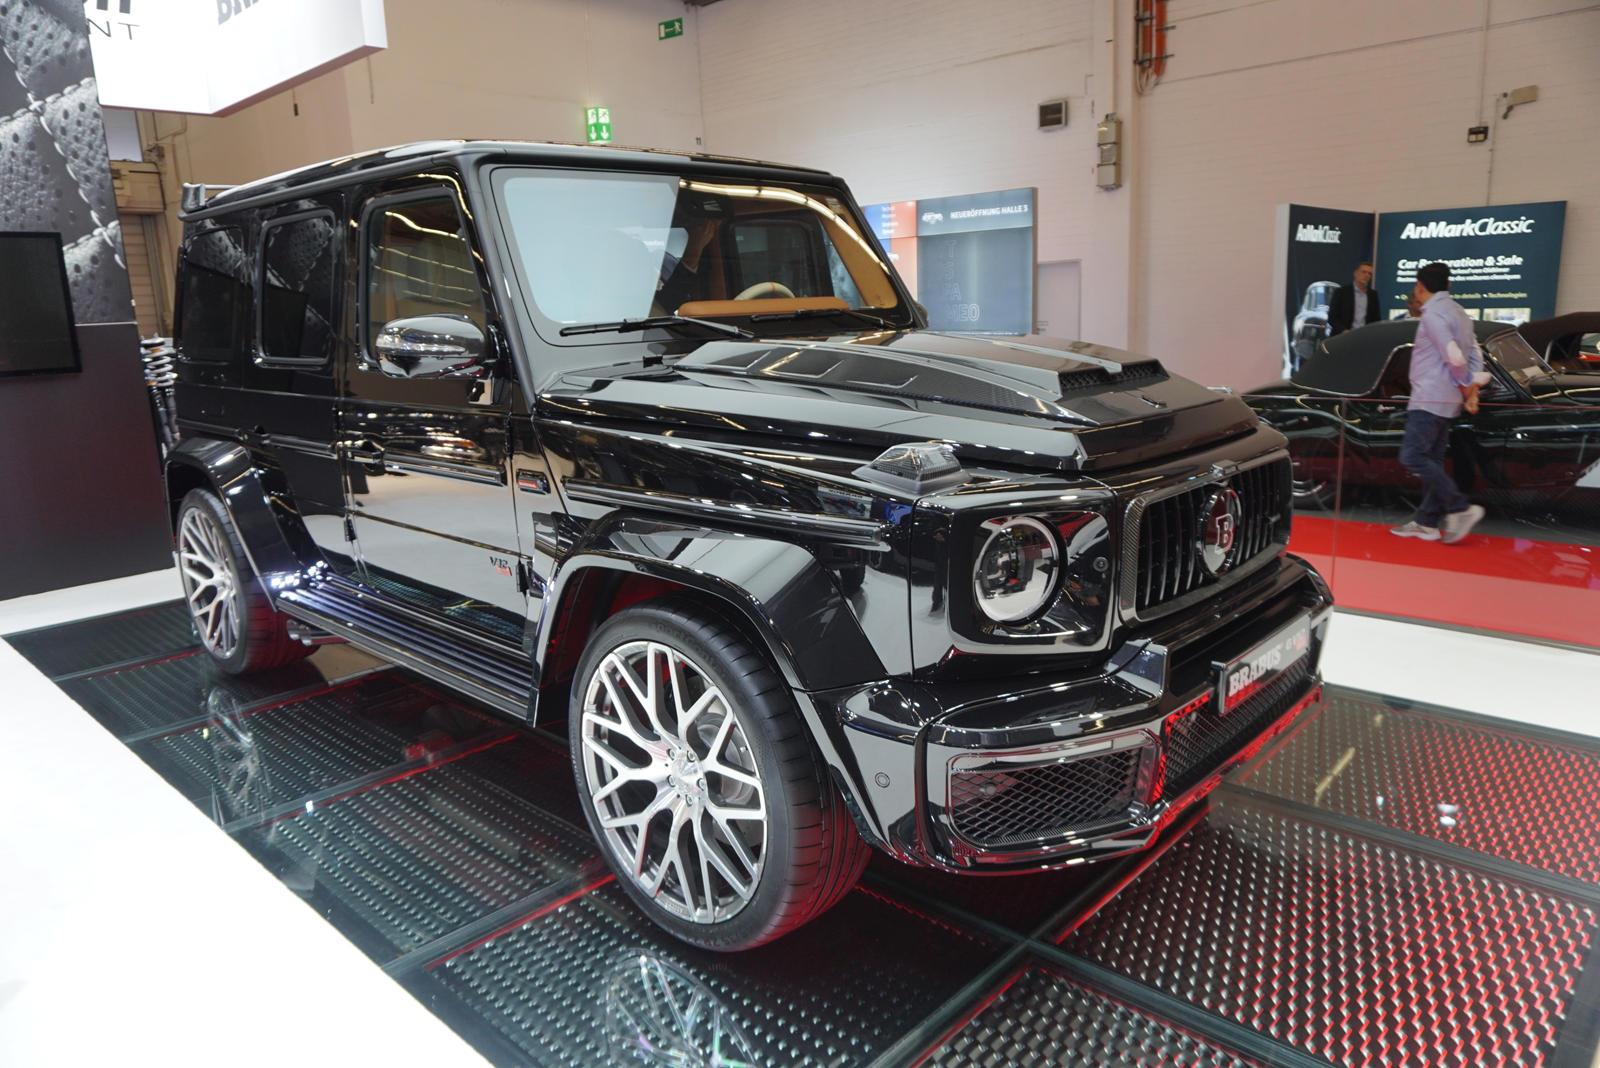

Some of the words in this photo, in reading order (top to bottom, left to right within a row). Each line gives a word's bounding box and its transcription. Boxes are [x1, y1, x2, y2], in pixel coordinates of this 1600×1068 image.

[1001, 205, 1022, 215] HALLE
[1399, 216, 1535, 240] AnMarkClassic
[1397, 259, 1418, 270] Car
[1484, 255, 1496, 266] &
[1496, 254, 1524, 266] Sale
[1214, 513, 1235, 555] B
[489, 556, 508, 569] V12
[1229, 644, 1281, 695] BRABUS
